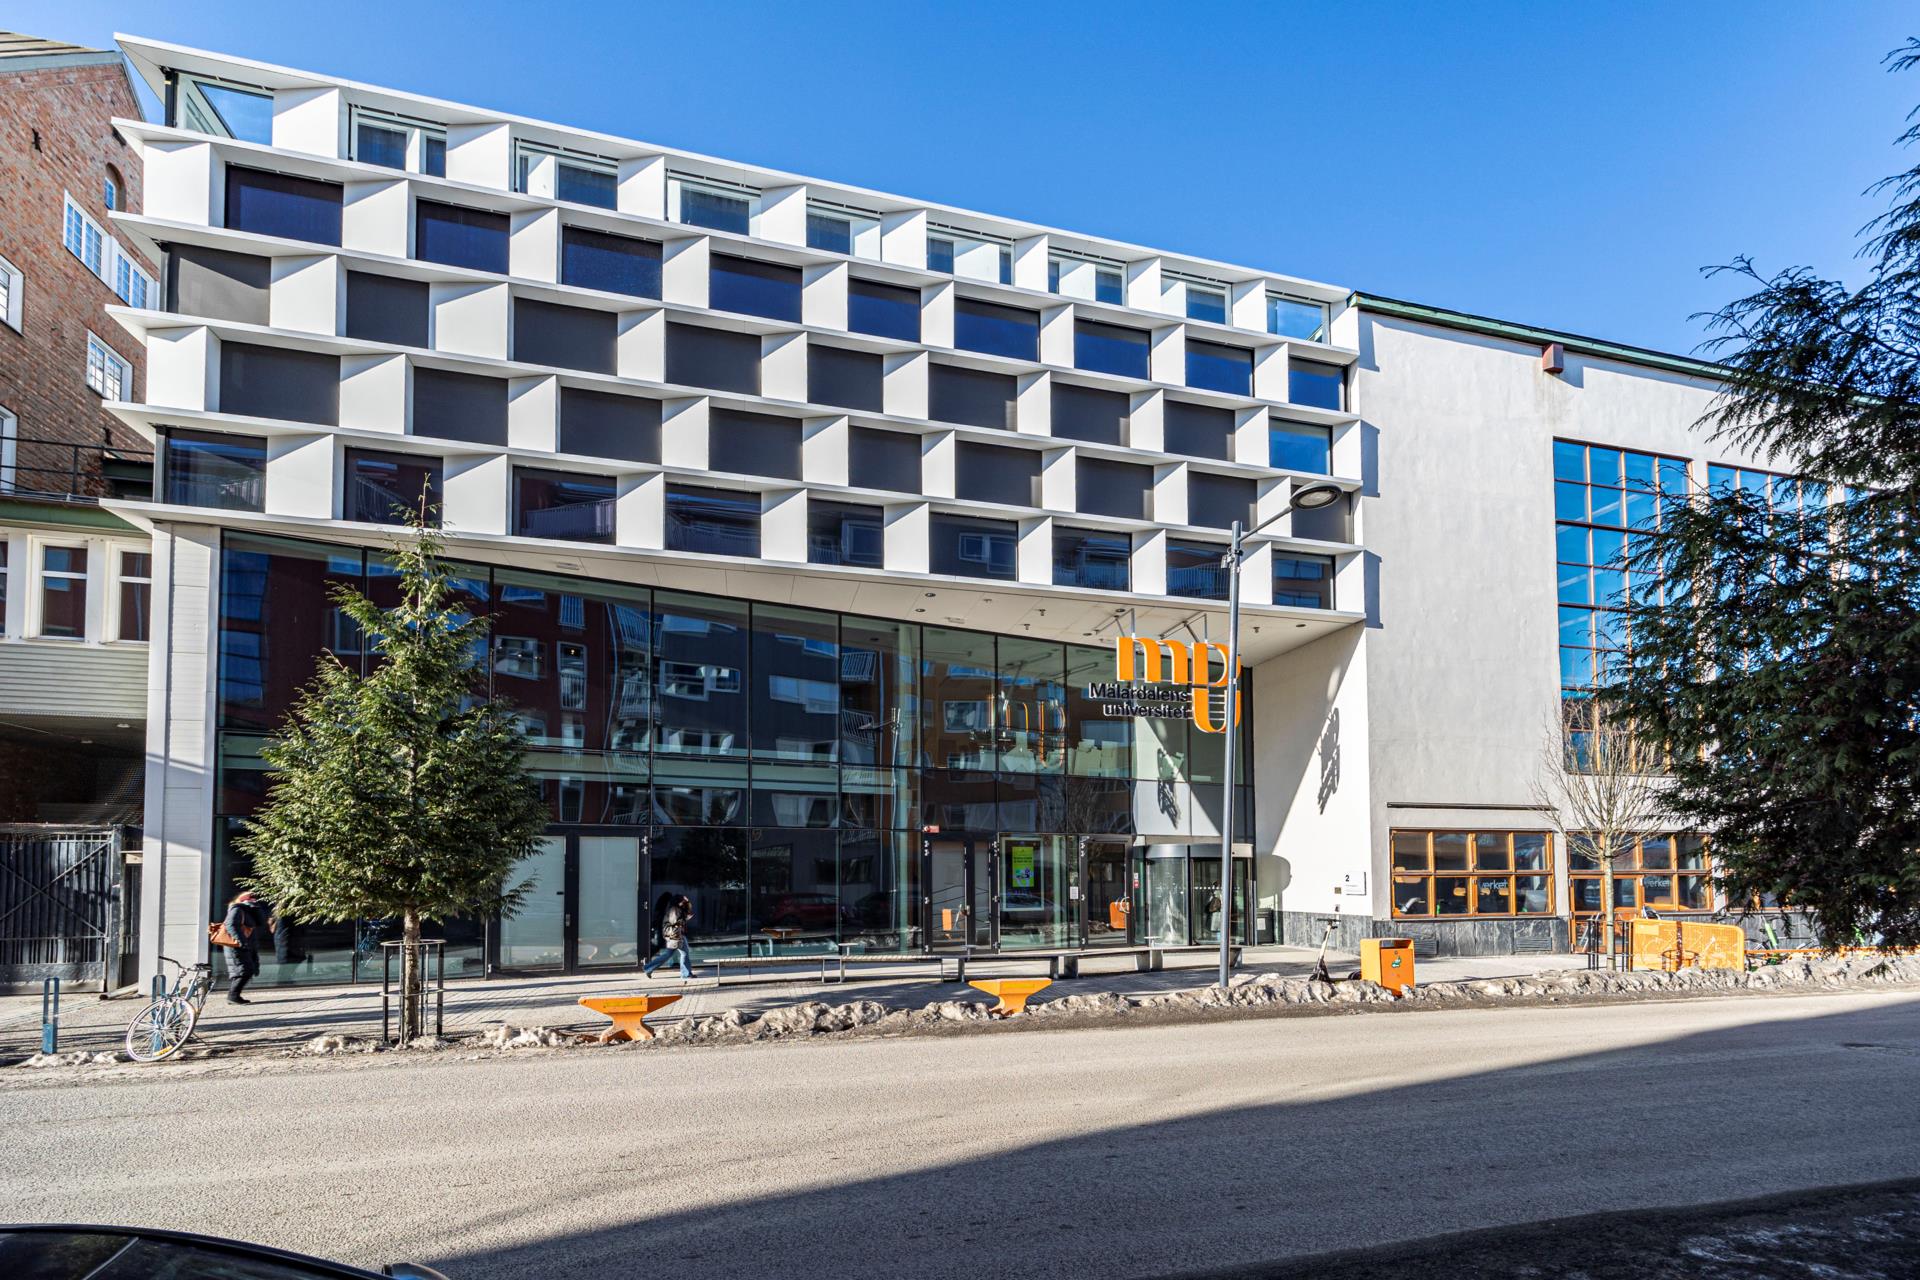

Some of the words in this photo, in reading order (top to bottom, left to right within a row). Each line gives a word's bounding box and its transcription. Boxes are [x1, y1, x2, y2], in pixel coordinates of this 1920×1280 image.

[1089, 682, 1188, 702] Mälardalens
[1103, 702, 1188, 719] universitet
[1345, 874, 1350, 882] 2
